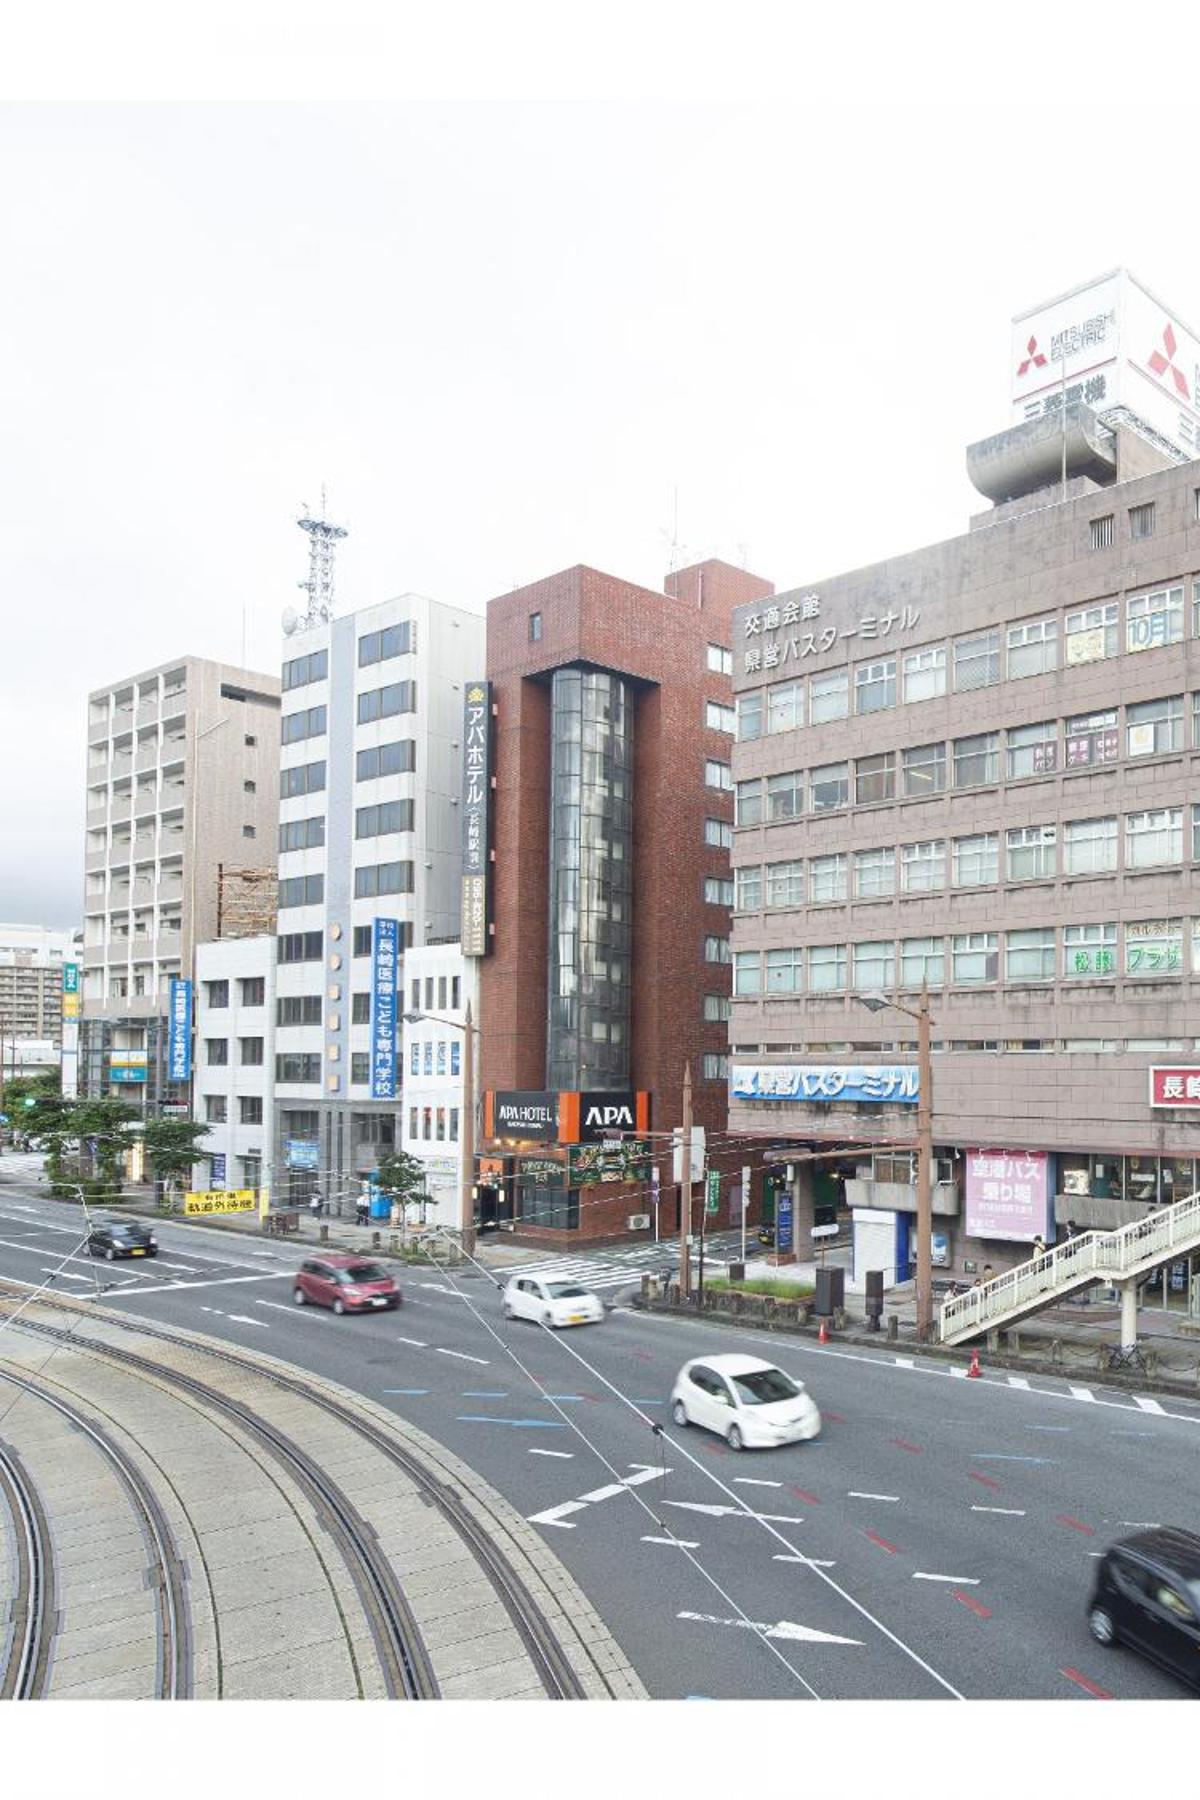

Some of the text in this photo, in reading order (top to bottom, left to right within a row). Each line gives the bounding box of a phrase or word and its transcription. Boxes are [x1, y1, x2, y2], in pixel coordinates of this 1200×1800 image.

[1050, 309, 1116, 348] MITSUBISHI
[744, 594, 821, 638] 交通会館
[744, 604, 921, 673] 県営バスターミナル
[585, 1106, 634, 1126] APA
